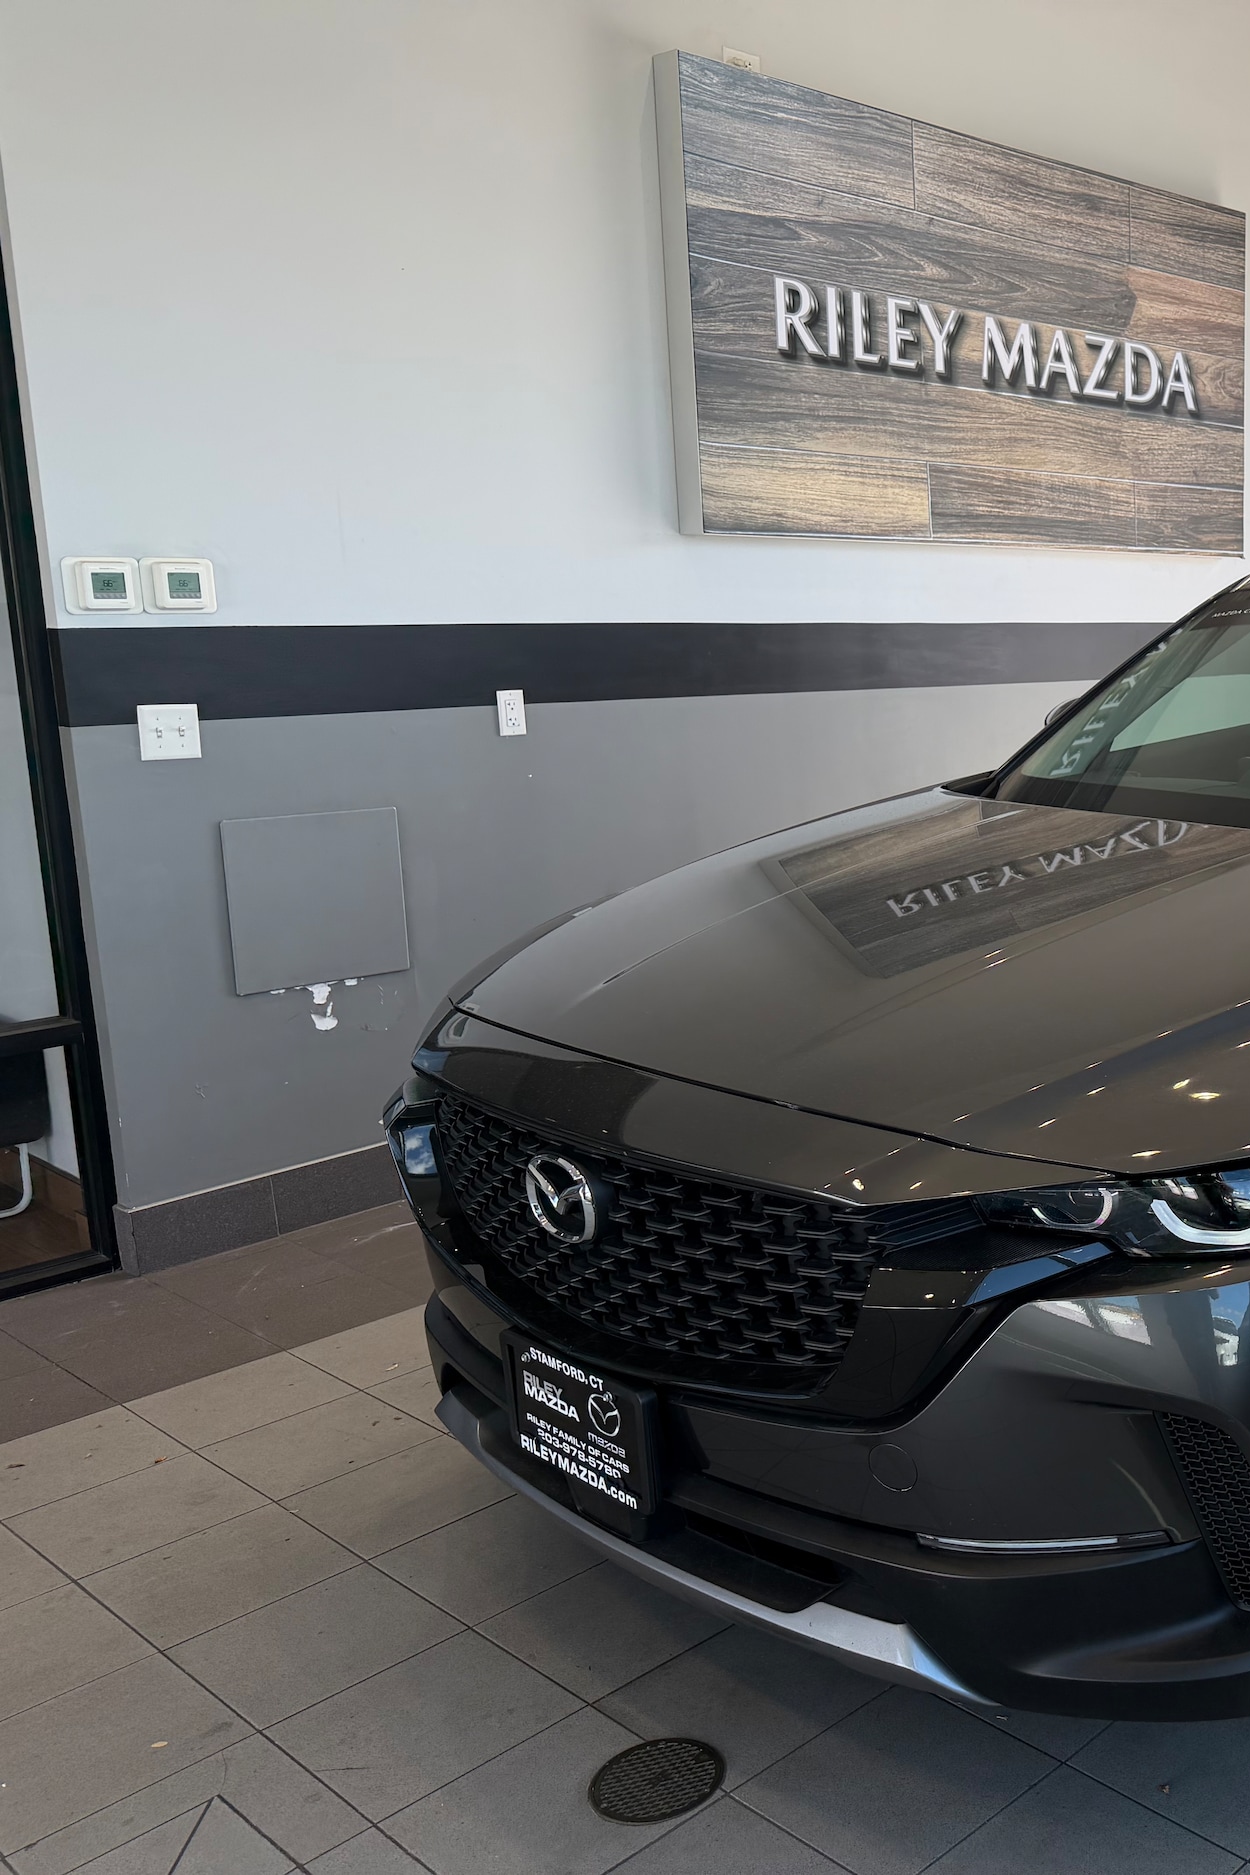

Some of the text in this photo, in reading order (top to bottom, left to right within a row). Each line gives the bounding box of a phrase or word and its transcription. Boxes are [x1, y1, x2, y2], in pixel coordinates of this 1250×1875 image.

[774, 275, 1199, 415] RILEY MAZDA
[1211, 609, 1243, 618] MAZDA
[522, 1370, 563, 1400] RILEY
[529, 1347, 604, 1392] STAMFORD, CT
[524, 1382, 580, 1422] MAZDA
[526, 1412, 630, 1474] RILEY FAMILY OF CARS
[520, 1434, 638, 1510] RILEYMAZDA.com
